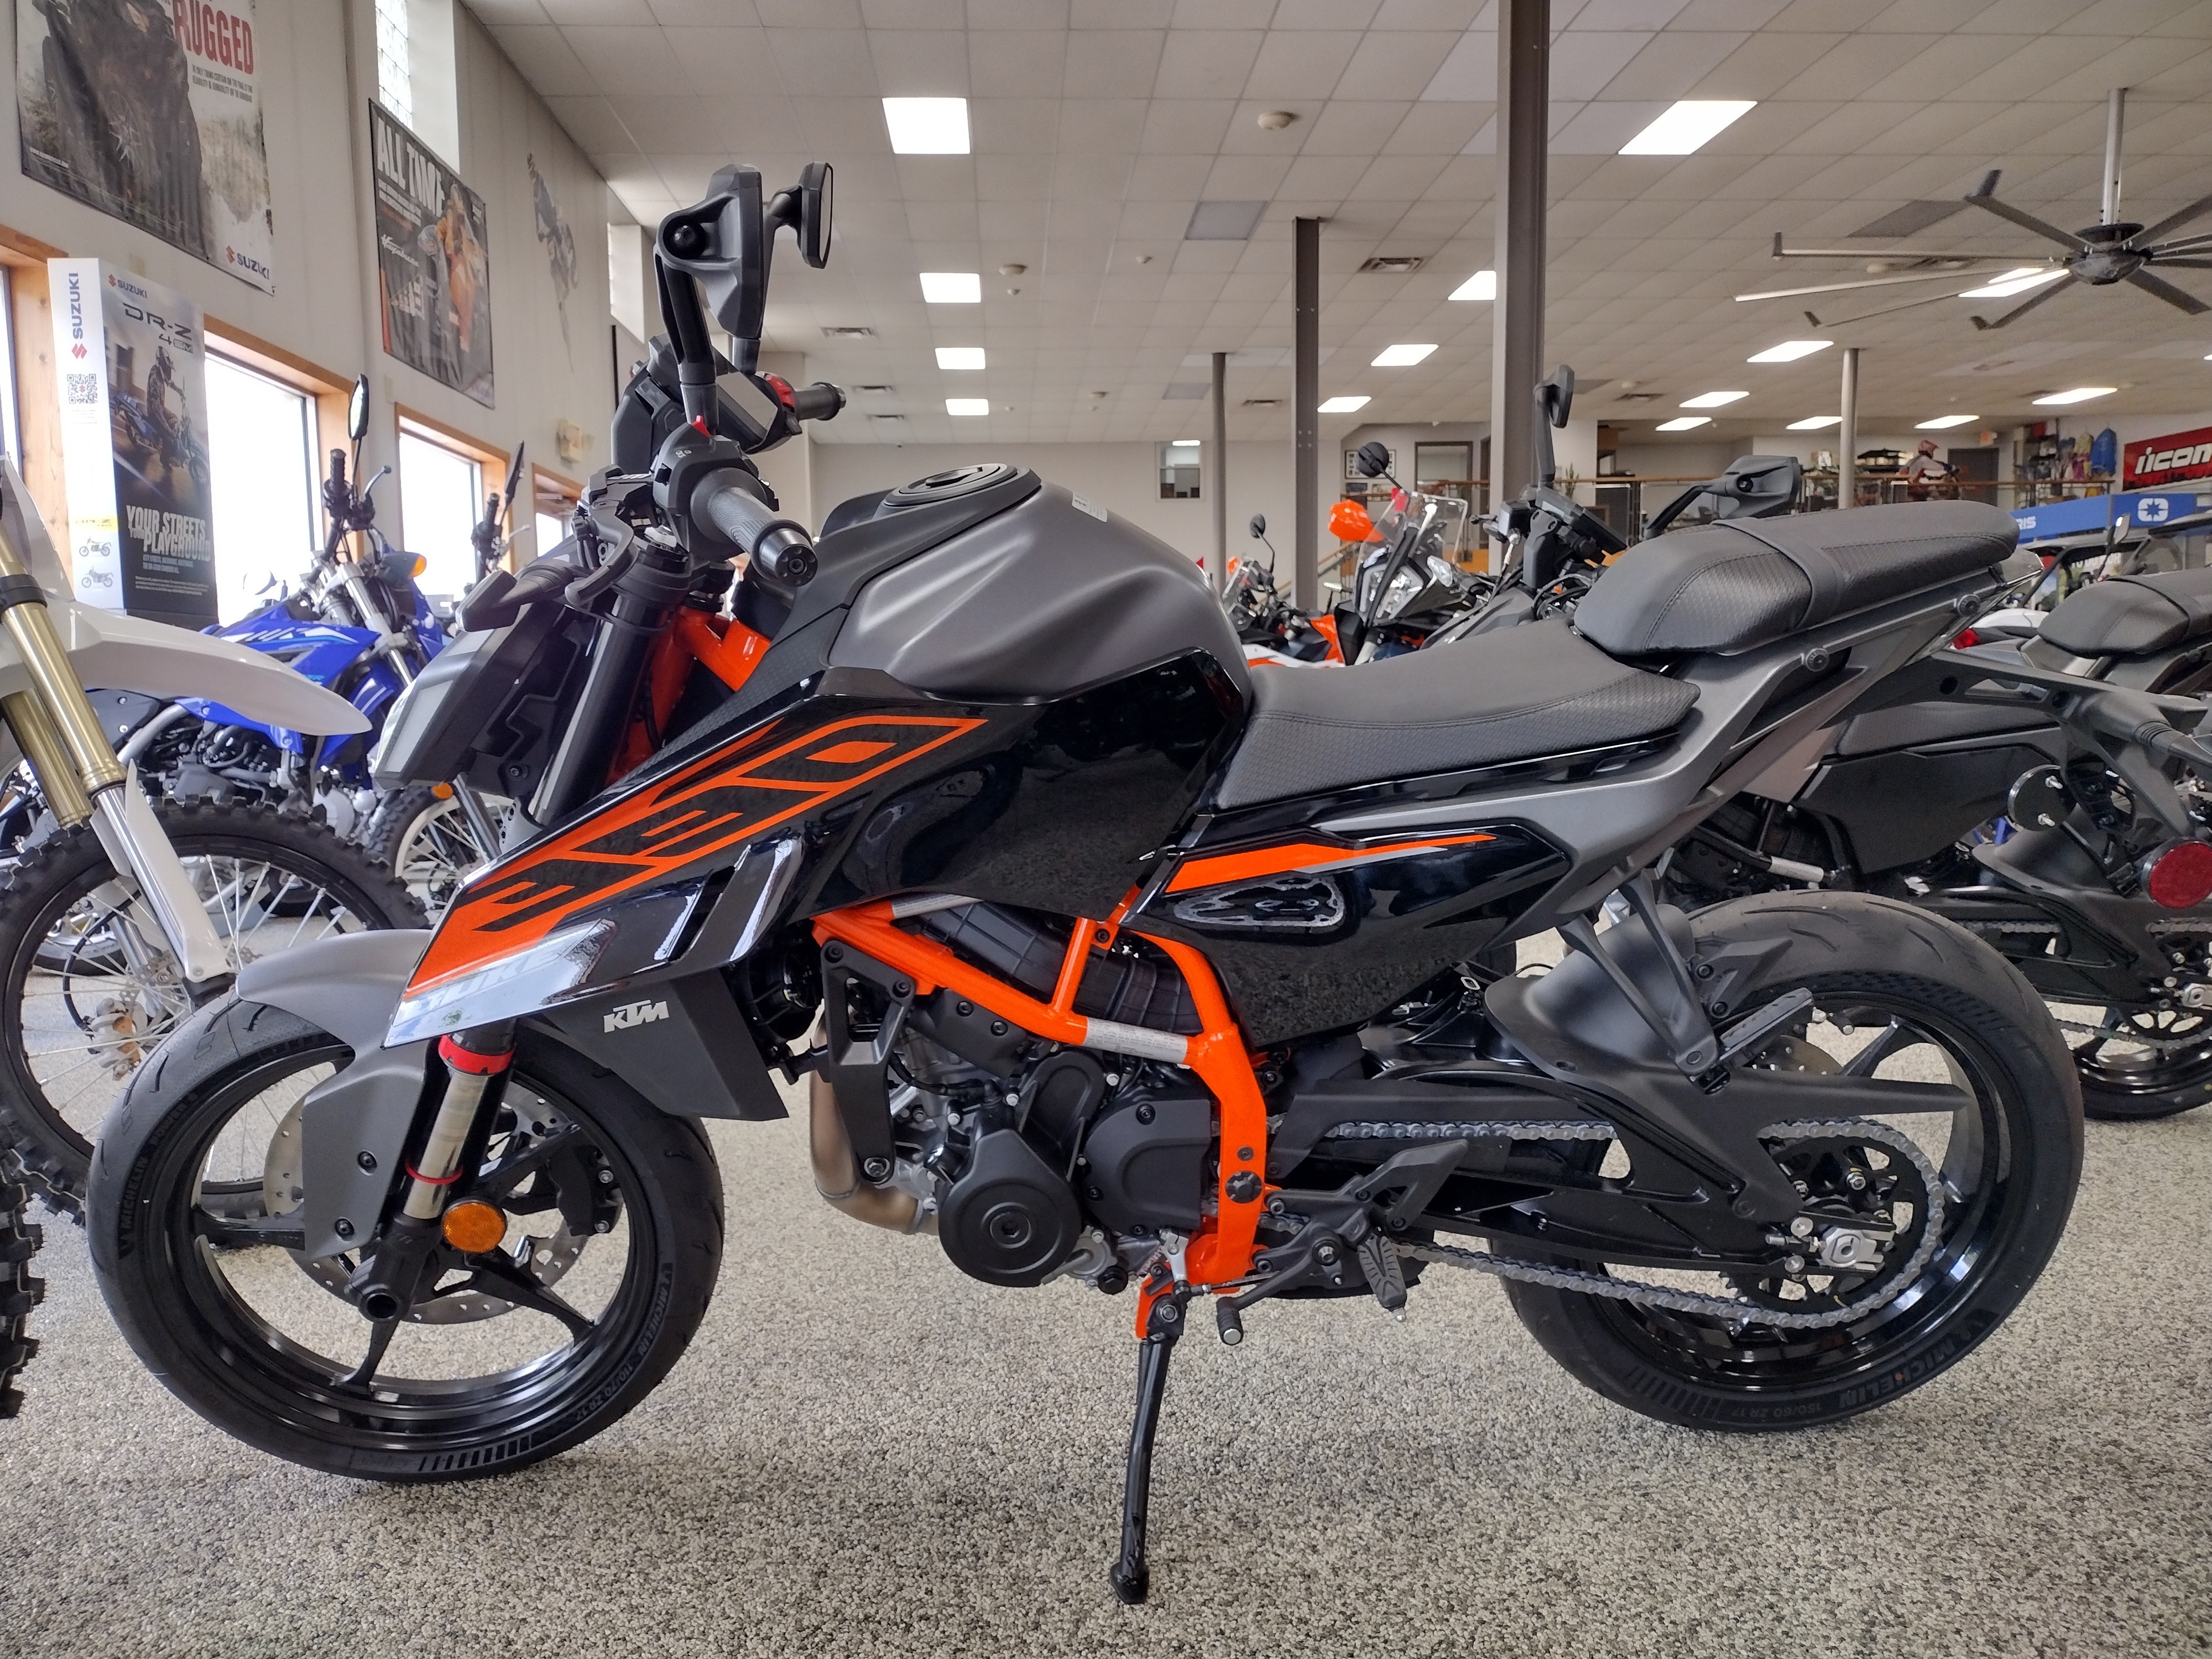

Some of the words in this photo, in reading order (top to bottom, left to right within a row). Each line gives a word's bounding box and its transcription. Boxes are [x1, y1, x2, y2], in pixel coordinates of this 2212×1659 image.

[173, 0, 253, 75] RUGGED
[377, 117, 405, 190] ALL
[237, 253, 269, 280] SUZUKI
[69, 273, 83, 340] SUZUKI
[117, 279, 148, 299] SUZUKI
[123, 302, 192, 341] DR-Z
[126, 505, 160, 534] YOUR
[163, 512, 206, 539] STREETS
[143, 529, 211, 562] PLAYGROUND
[603, 999, 670, 1033] KTM
[638, 1285, 669, 1356] MICHELIN
[1839, 1338, 1957, 1408] MICHELIN
[1773, 1402, 1821, 1417] 150/60
